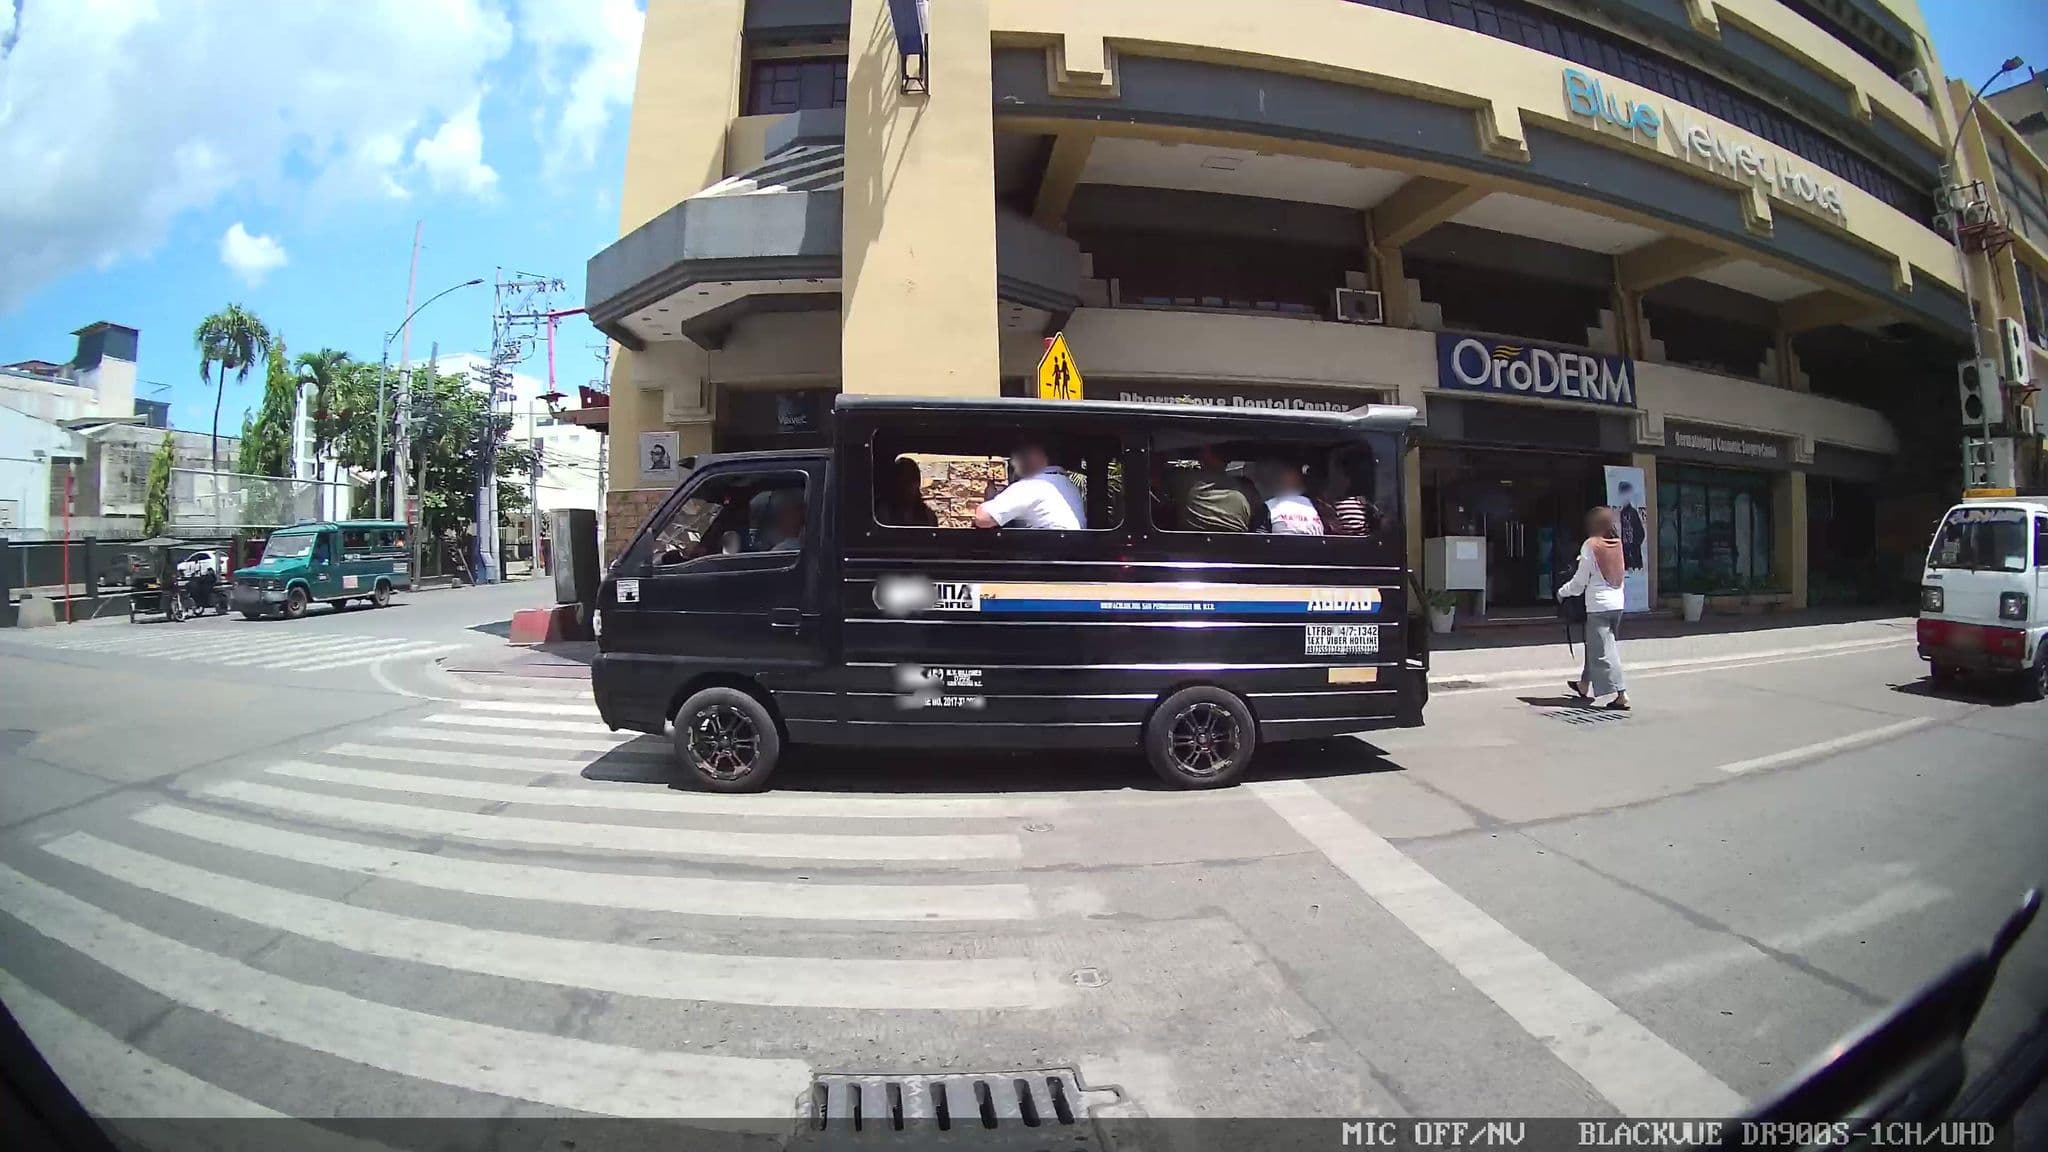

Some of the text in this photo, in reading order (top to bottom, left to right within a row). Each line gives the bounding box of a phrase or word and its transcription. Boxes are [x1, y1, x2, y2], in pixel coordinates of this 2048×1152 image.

[1563, 68, 1848, 216] Blue Velvet Hotel
[1453, 339, 1632, 404] OroDERM
[1119, 392, 1213, 406] Pharmcy
[1232, 396, 1290, 410] Dental
[1293, 398, 1349, 412] Center
[1307, 627, 1332, 636] LTFRB
[1307, 637, 1378, 645] TEXT VIBER HOTLINE
